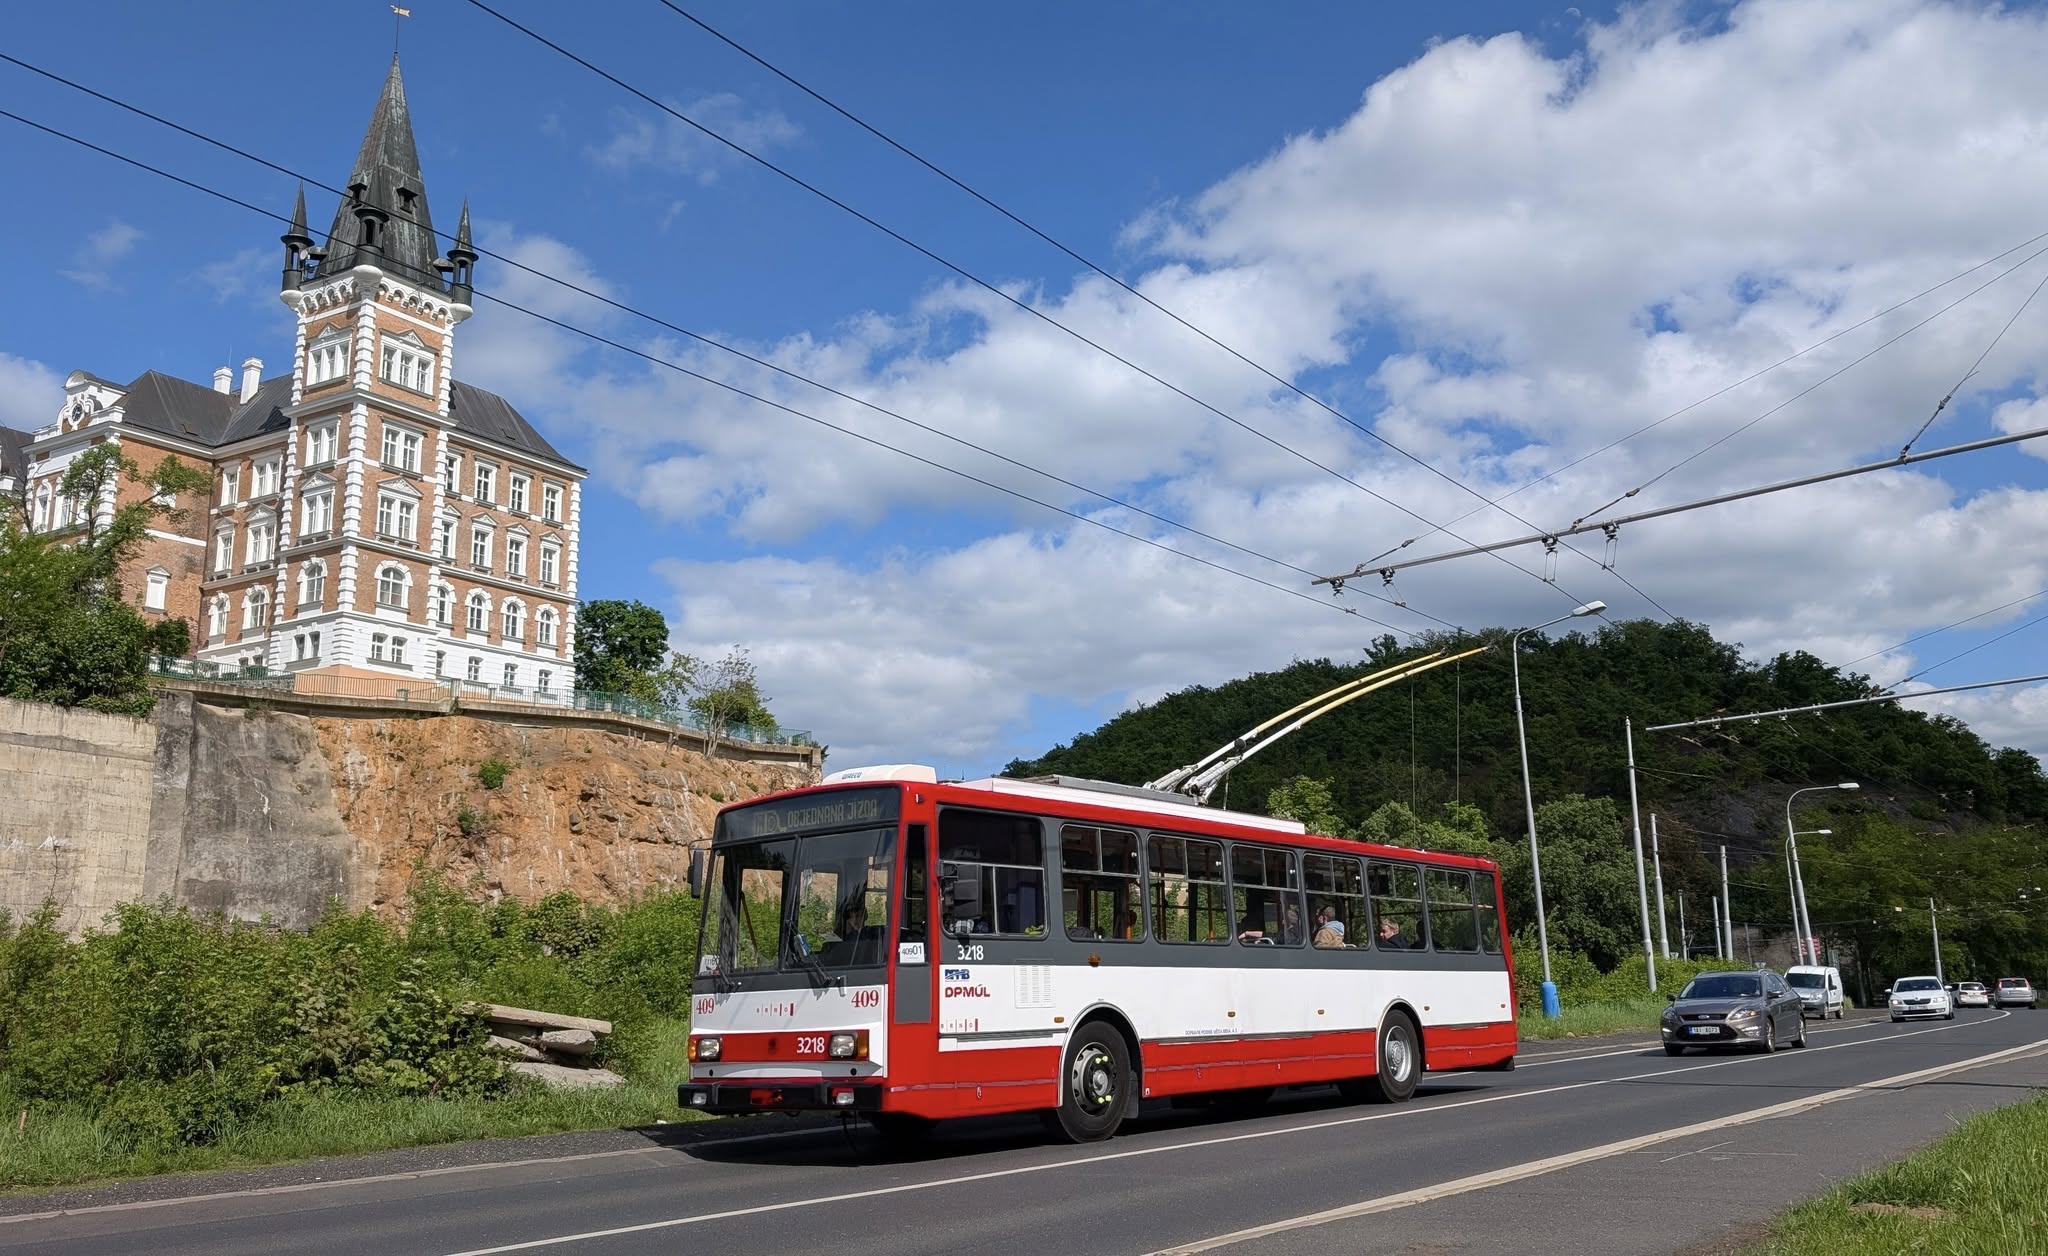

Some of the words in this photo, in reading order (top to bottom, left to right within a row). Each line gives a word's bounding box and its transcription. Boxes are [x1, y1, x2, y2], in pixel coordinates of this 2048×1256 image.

[957, 945, 984, 960] 3218
[851, 990, 879, 1007] 409
[945, 984, 990, 998] DPMÚL
[696, 998, 715, 1014] 409
[797, 1037, 825, 1053] 3218
